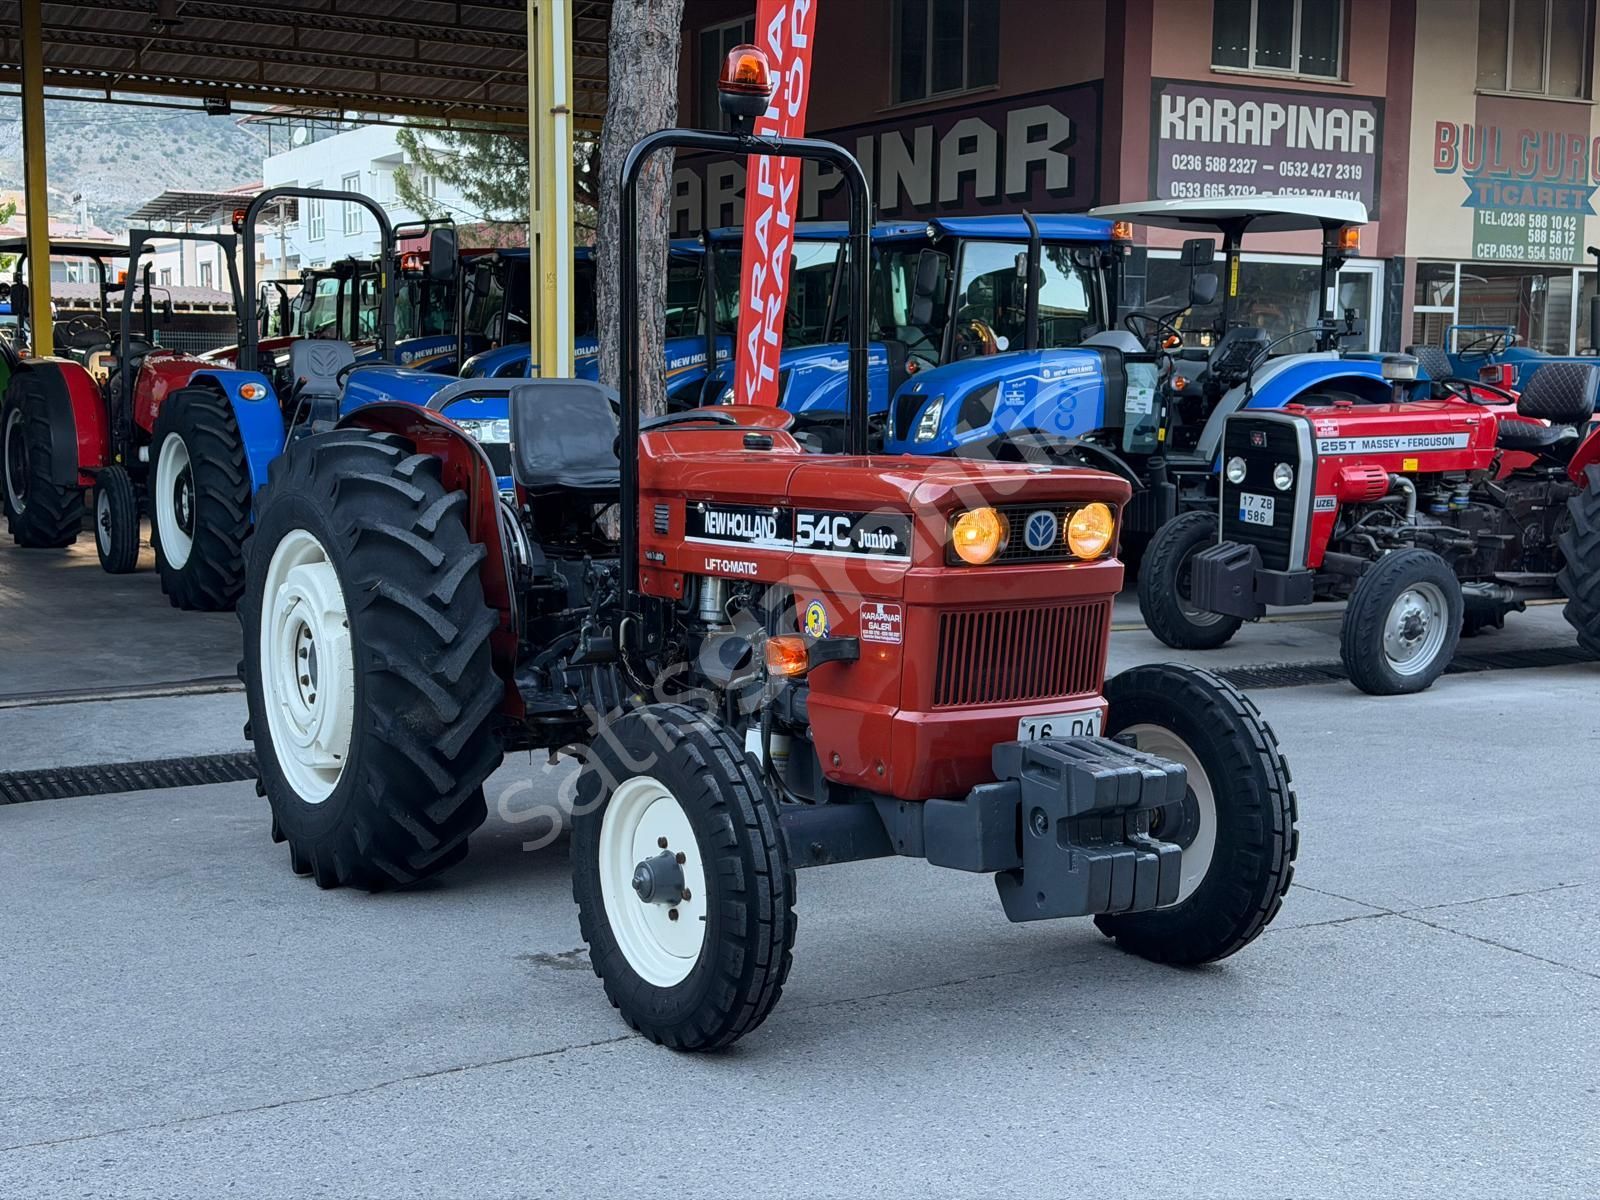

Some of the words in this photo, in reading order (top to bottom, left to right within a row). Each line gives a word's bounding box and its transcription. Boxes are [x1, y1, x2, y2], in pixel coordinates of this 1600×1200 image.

[1160, 94, 1375, 154] KARAPINAR
[671, 105, 1070, 232] ARPINAR
[1172, 153, 1202, 171] 0236
[1205, 156, 1227, 172] 588
[1228, 158, 1258, 174] 2327
[1279, 160, 1309, 178] 0532
[1310, 162, 1333, 178] 427
[1335, 164, 1362, 180] 2319
[757, 0, 810, 392] TRAKÖR
[1171, 181, 1201, 198] 0533
[1203, 183, 1225, 198] 665
[1528, 214, 1548, 228] 588
[1528, 229, 1547, 243] 588
[1527, 246, 1546, 260] 554
[413, 348, 433, 360] NEW
[433, 342, 468, 355] HOLLAD
[670, 356, 690, 369] NEW
[691, 350, 728, 364] HOLND
[1243, 495, 1254, 506] 17
[1260, 497, 1272, 509] ZB
[1315, 499, 1335, 508] UZEL
[1247, 510, 1266, 522] 586
[705, 511, 726, 535] NEW
[726, 512, 777, 539] HOLLAND
[796, 514, 851, 547] 54C
[857, 528, 898, 549] Junior
[862, 612, 900, 622] KARAPINAR
[1028, 723, 1053, 740] 16
